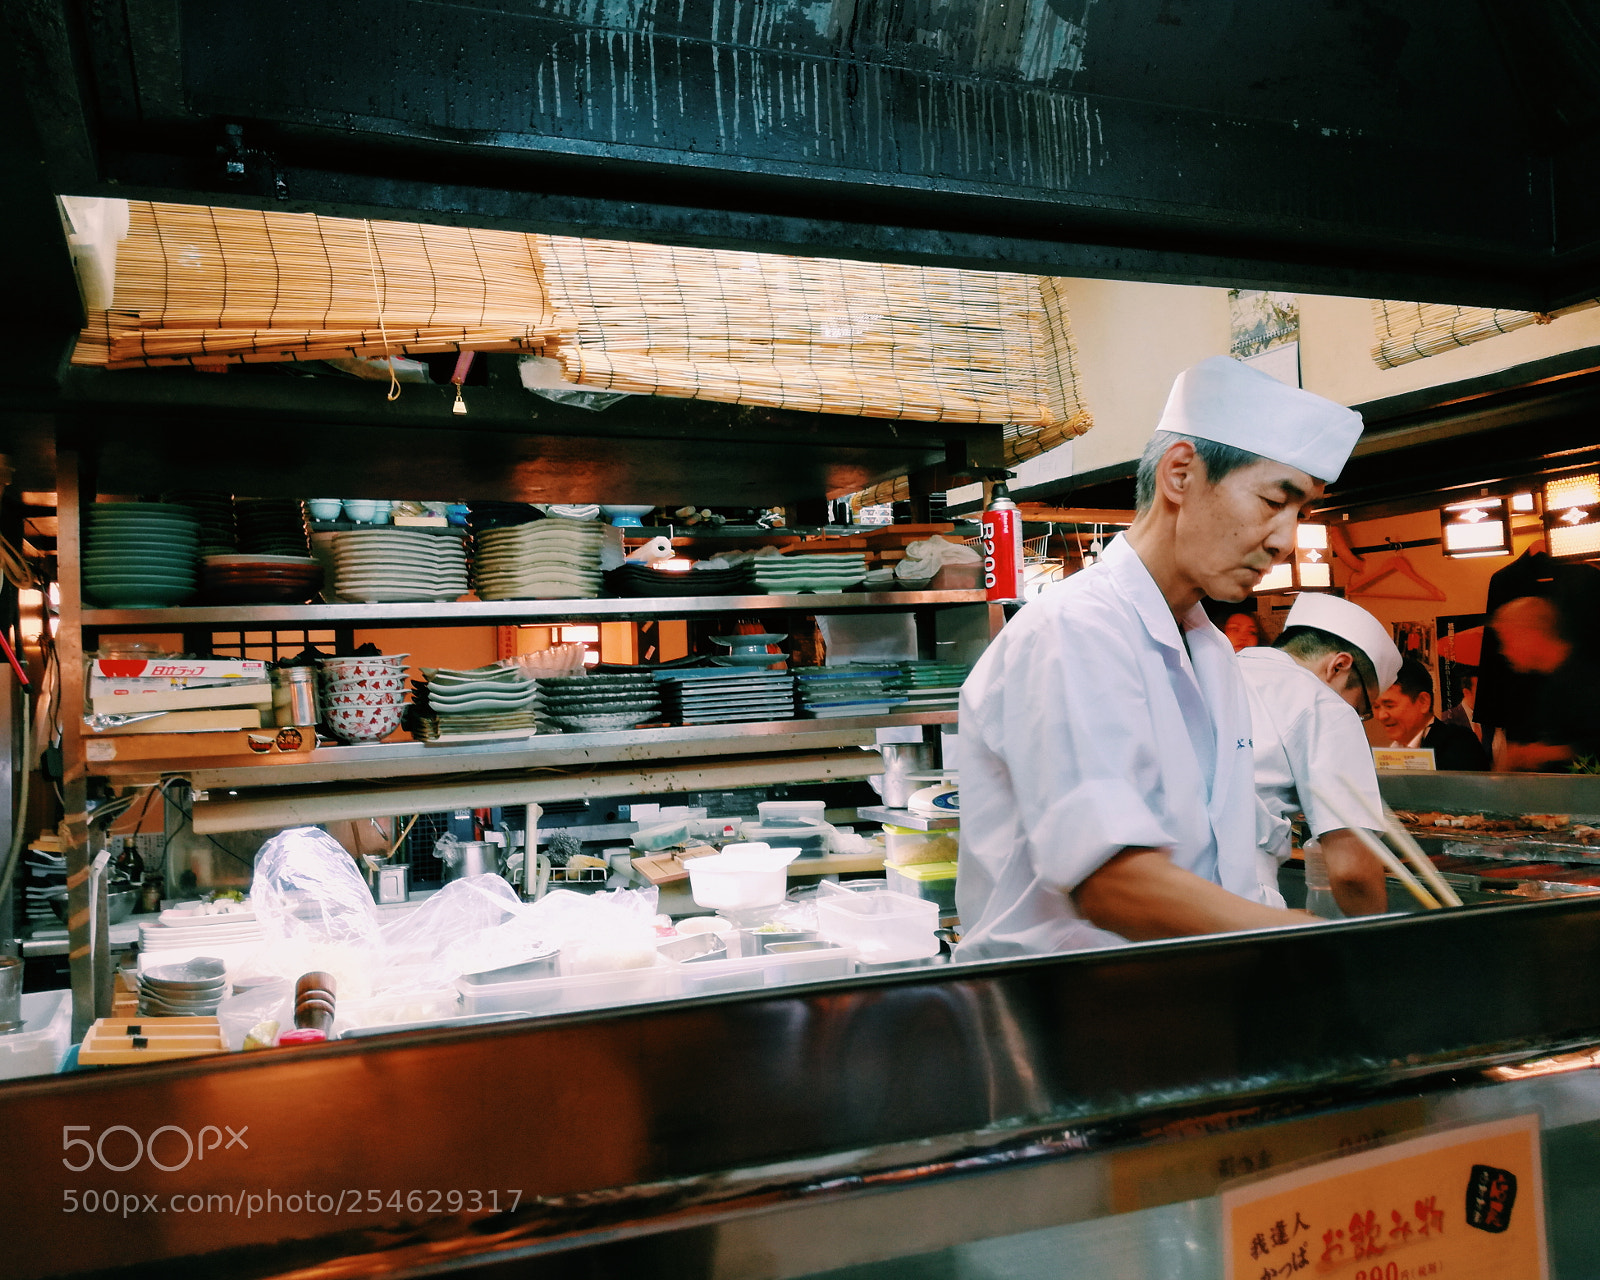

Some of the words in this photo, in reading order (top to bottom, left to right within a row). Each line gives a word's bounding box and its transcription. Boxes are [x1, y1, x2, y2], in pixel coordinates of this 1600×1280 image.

[982, 522, 997, 589] R200
[151, 665, 207, 676] 日立ラップ
[1320, 1196, 1444, 1262] お飲み物
